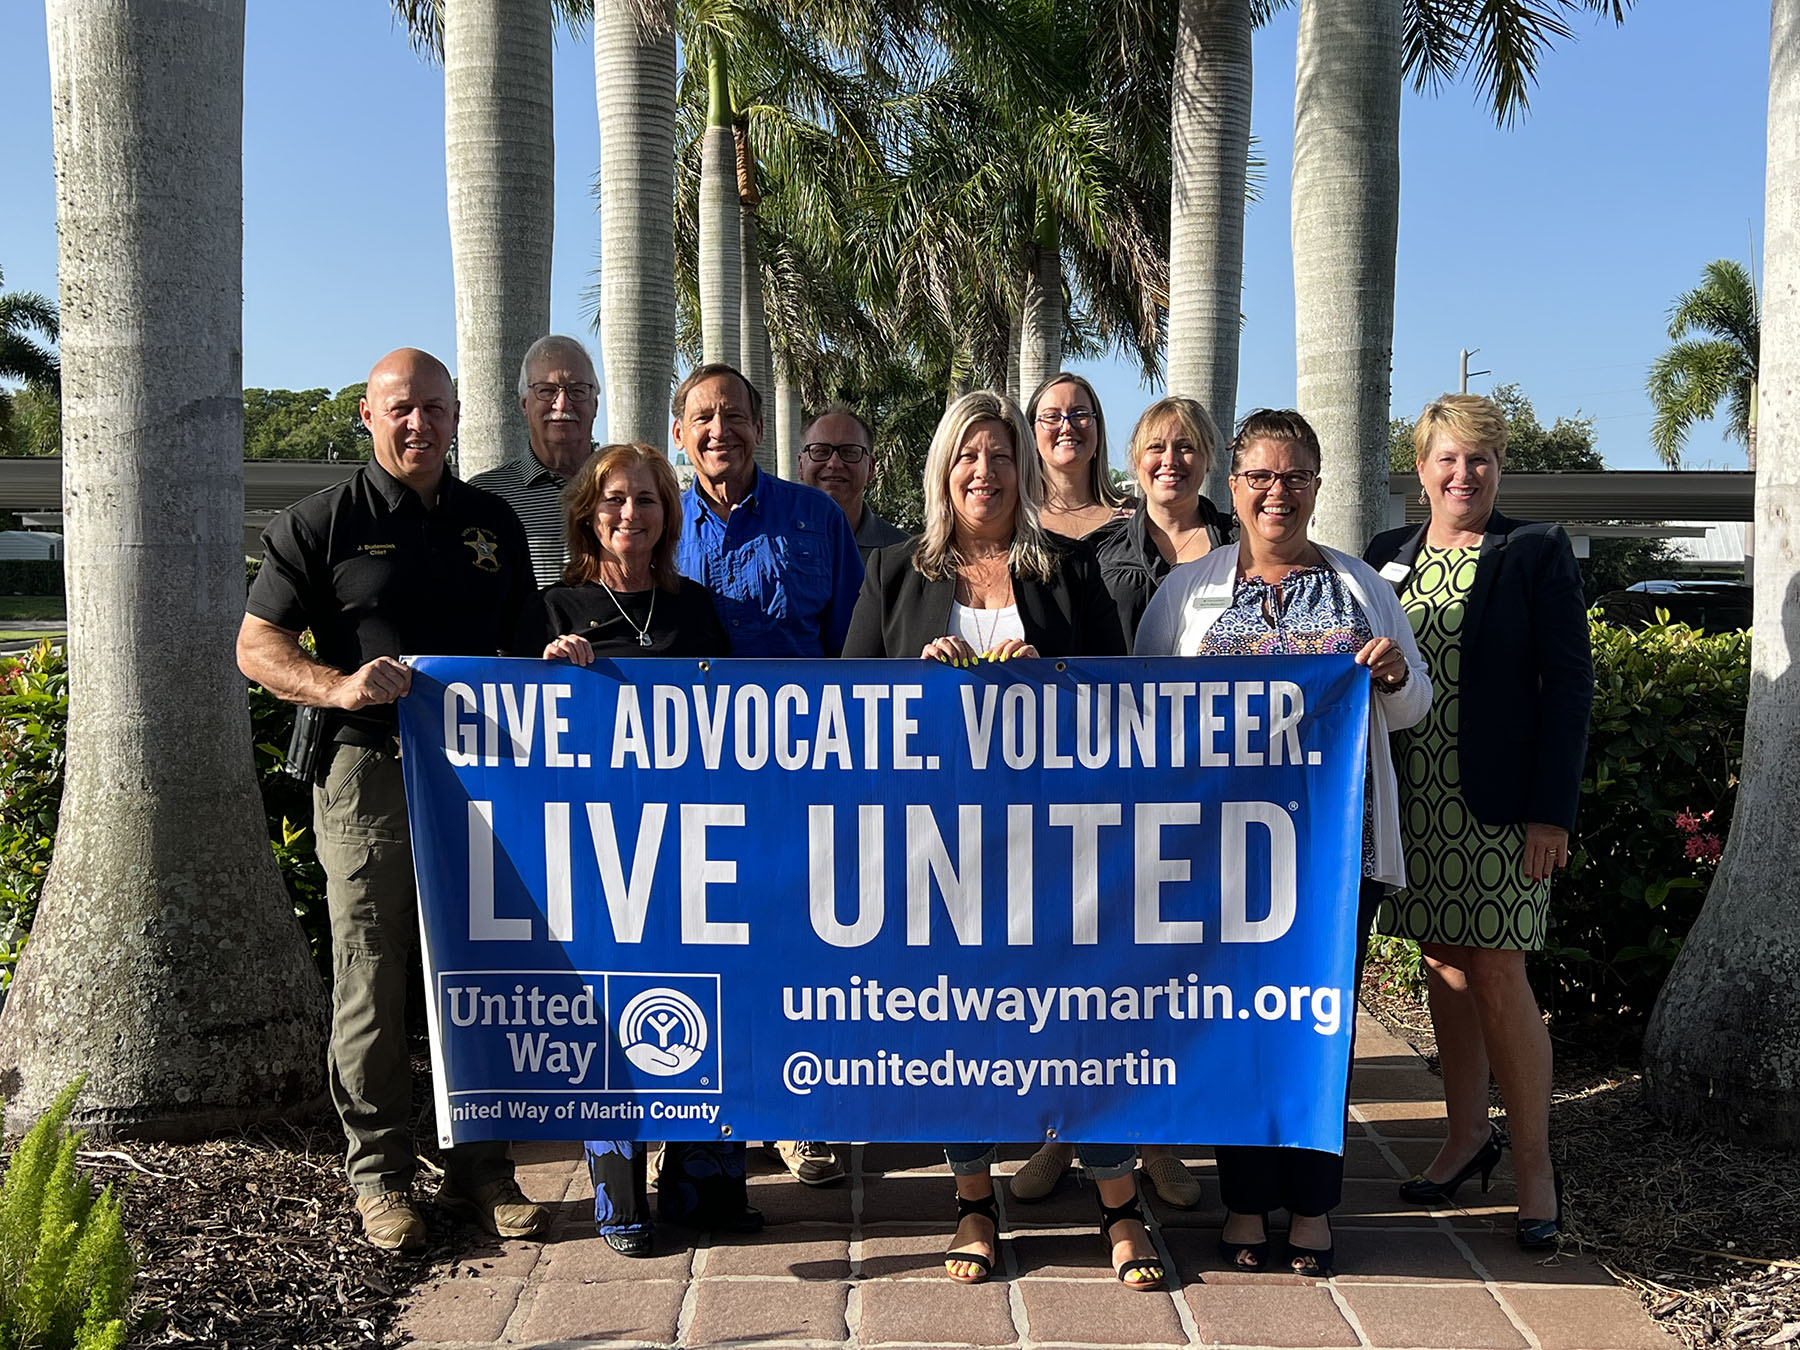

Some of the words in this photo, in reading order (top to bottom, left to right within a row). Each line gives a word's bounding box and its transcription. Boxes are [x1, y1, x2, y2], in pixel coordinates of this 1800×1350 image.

[444, 681, 591, 768] GIVE.
[611, 683, 940, 770] ADVOCATE.
[960, 680, 1322, 770] VOLUNTEER.
[468, 800, 750, 945] LIVE
[447, 984, 597, 1027] United
[782, 974, 1341, 1036] unitedwaymartin.org
[506, 1032, 597, 1085] Way
[782, 1049, 1177, 1096] @unitedwaymartin
[508, 1101, 549, 1124] Way
[555, 1101, 575, 1120] of
[580, 1101, 644, 1120] Martin
[650, 1101, 720, 1124] County
